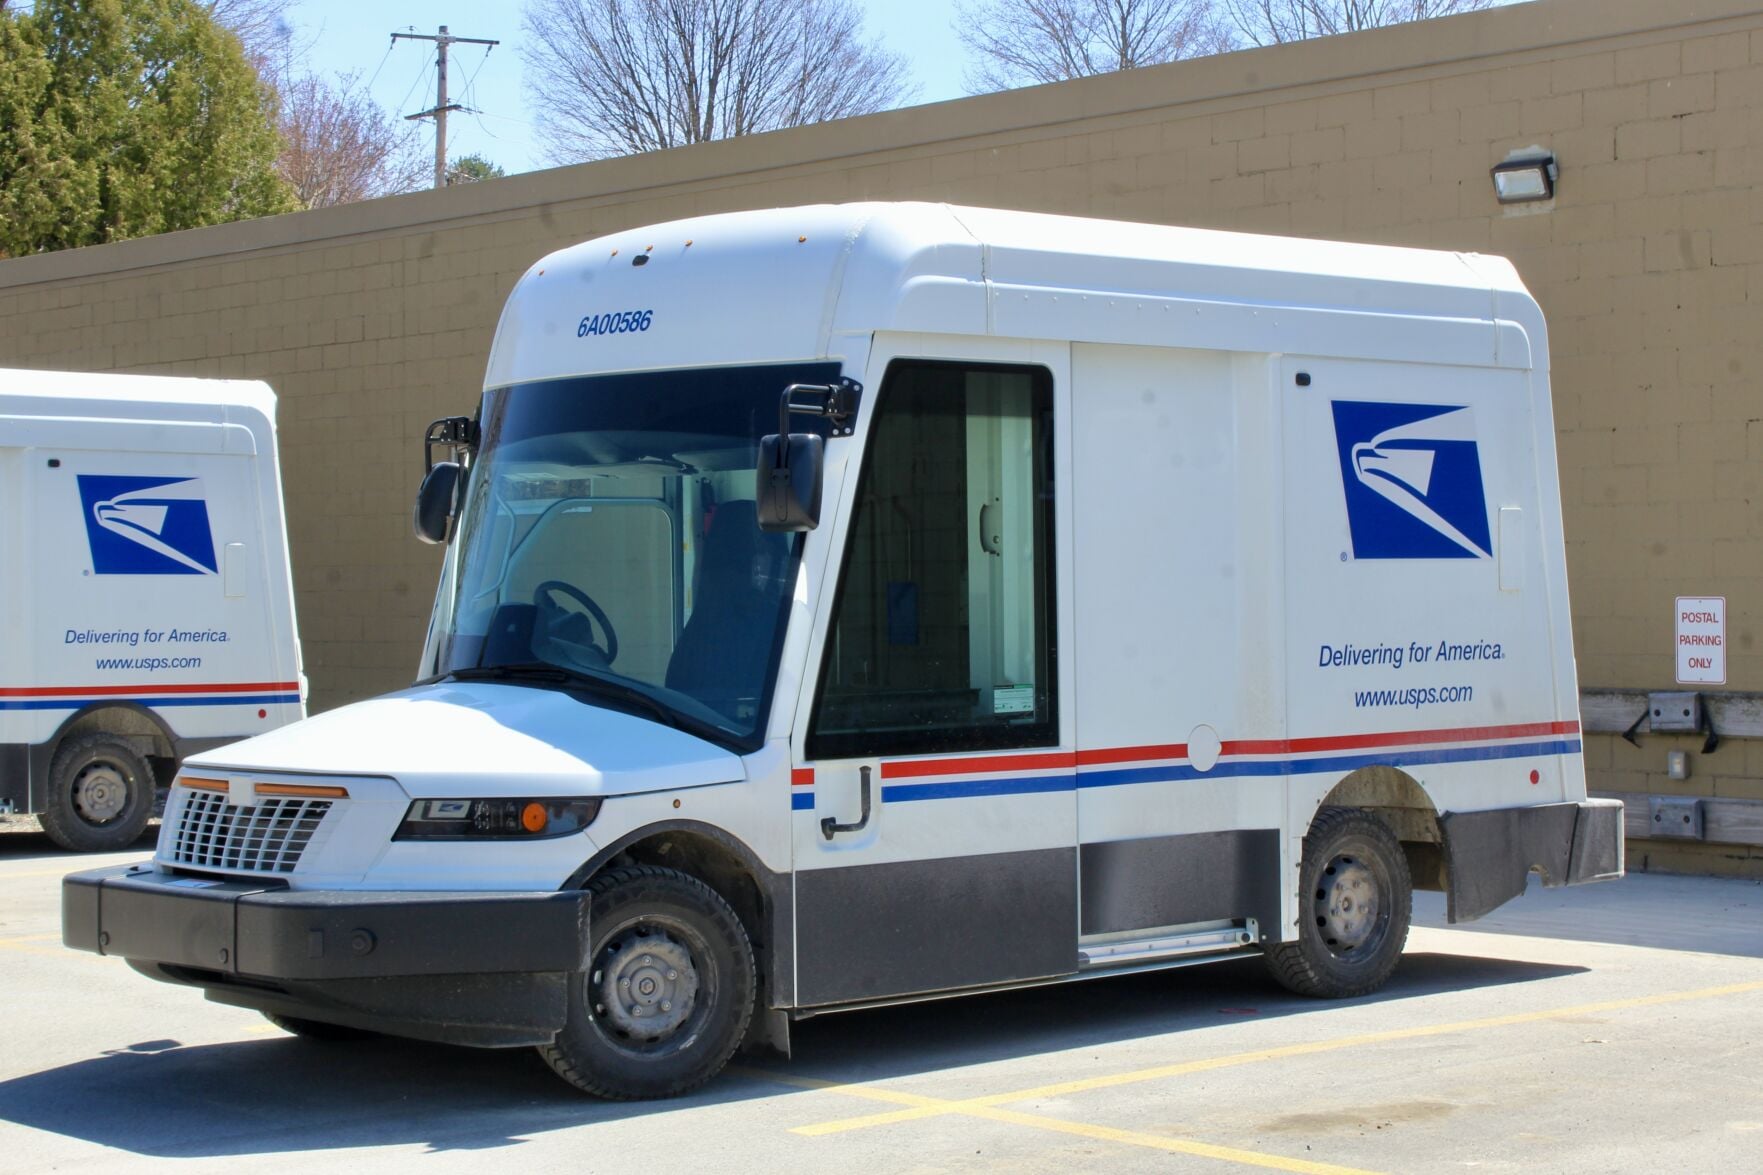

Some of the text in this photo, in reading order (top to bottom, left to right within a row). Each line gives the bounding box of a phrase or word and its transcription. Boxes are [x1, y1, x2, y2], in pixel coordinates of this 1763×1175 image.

[577, 309, 653, 338] 6A00586
[1681, 612, 1719, 624] POSTAL
[65, 629, 140, 647] Delivering
[144, 628, 165, 643] for
[1679, 634, 1722, 646] PARKING
[1319, 643, 1404, 669] Delivering
[1408, 641, 1433, 664] for
[1688, 657, 1712, 669] ONLY
[96, 657, 202, 672] www.usps.com
[1354, 685, 1474, 710] www.usps.com
